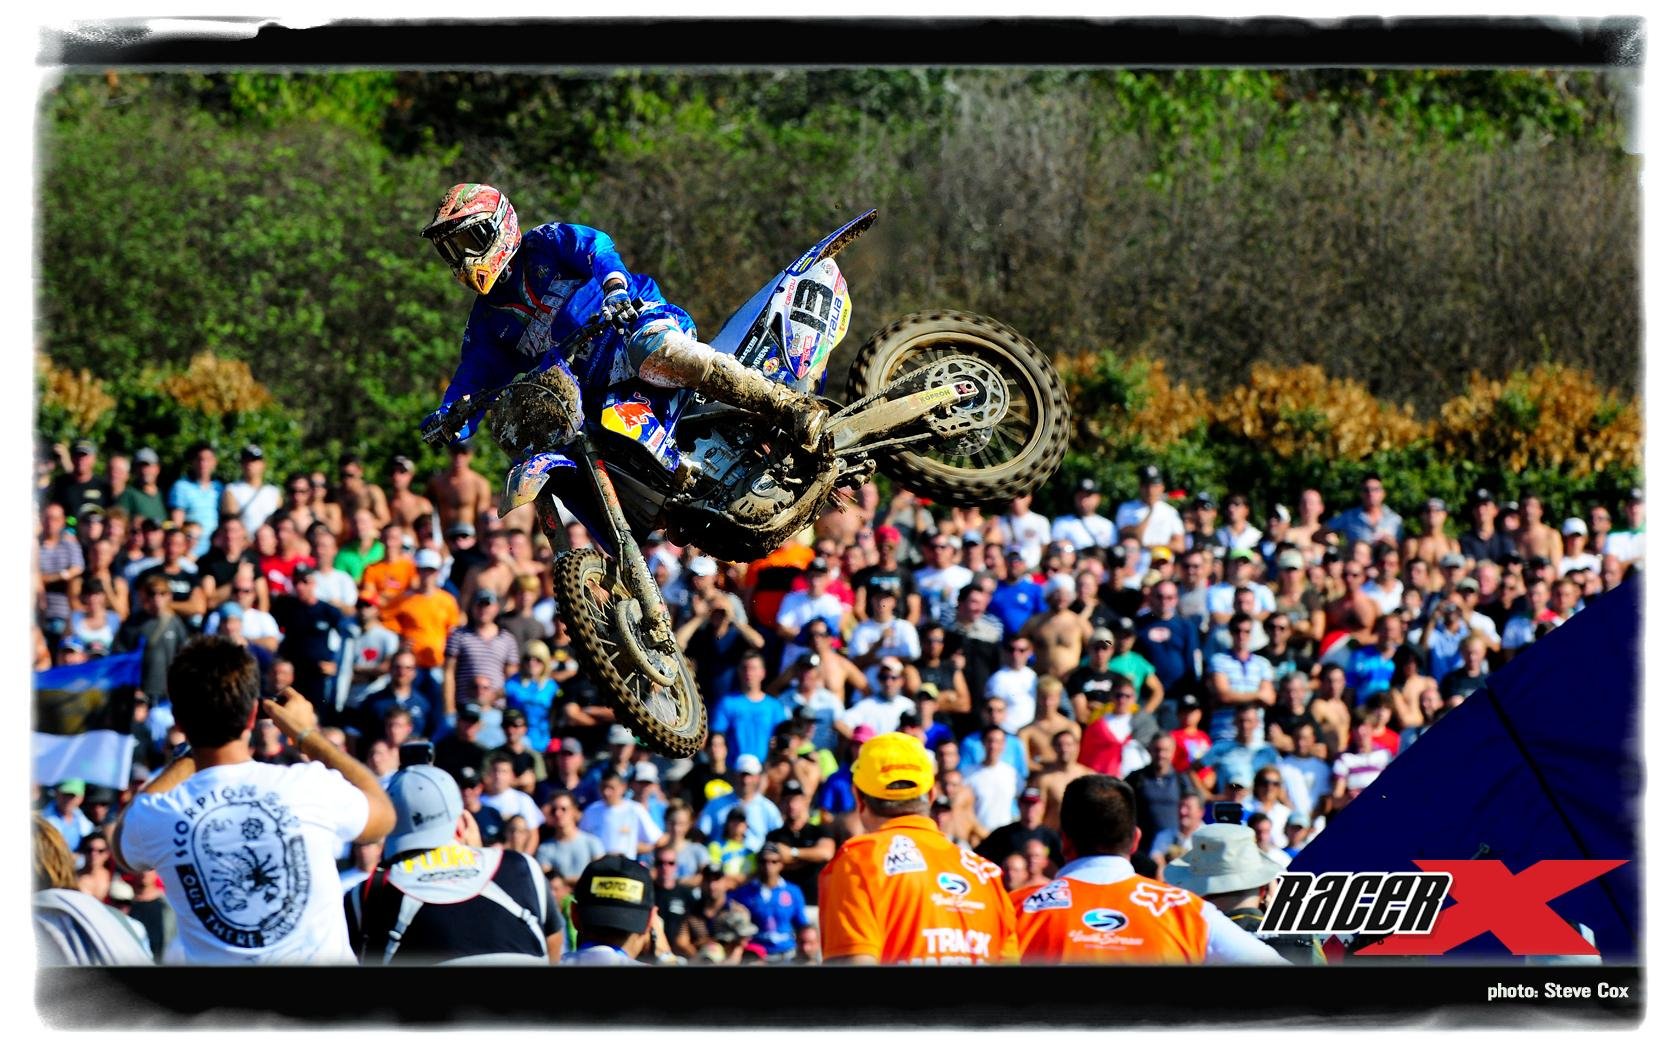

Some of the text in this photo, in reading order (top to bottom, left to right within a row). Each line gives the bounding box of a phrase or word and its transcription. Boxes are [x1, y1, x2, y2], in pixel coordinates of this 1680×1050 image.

[790, 279, 834, 334] 13
[173, 784, 258, 859] SCORPION
[922, 927, 991, 958] TRACK
